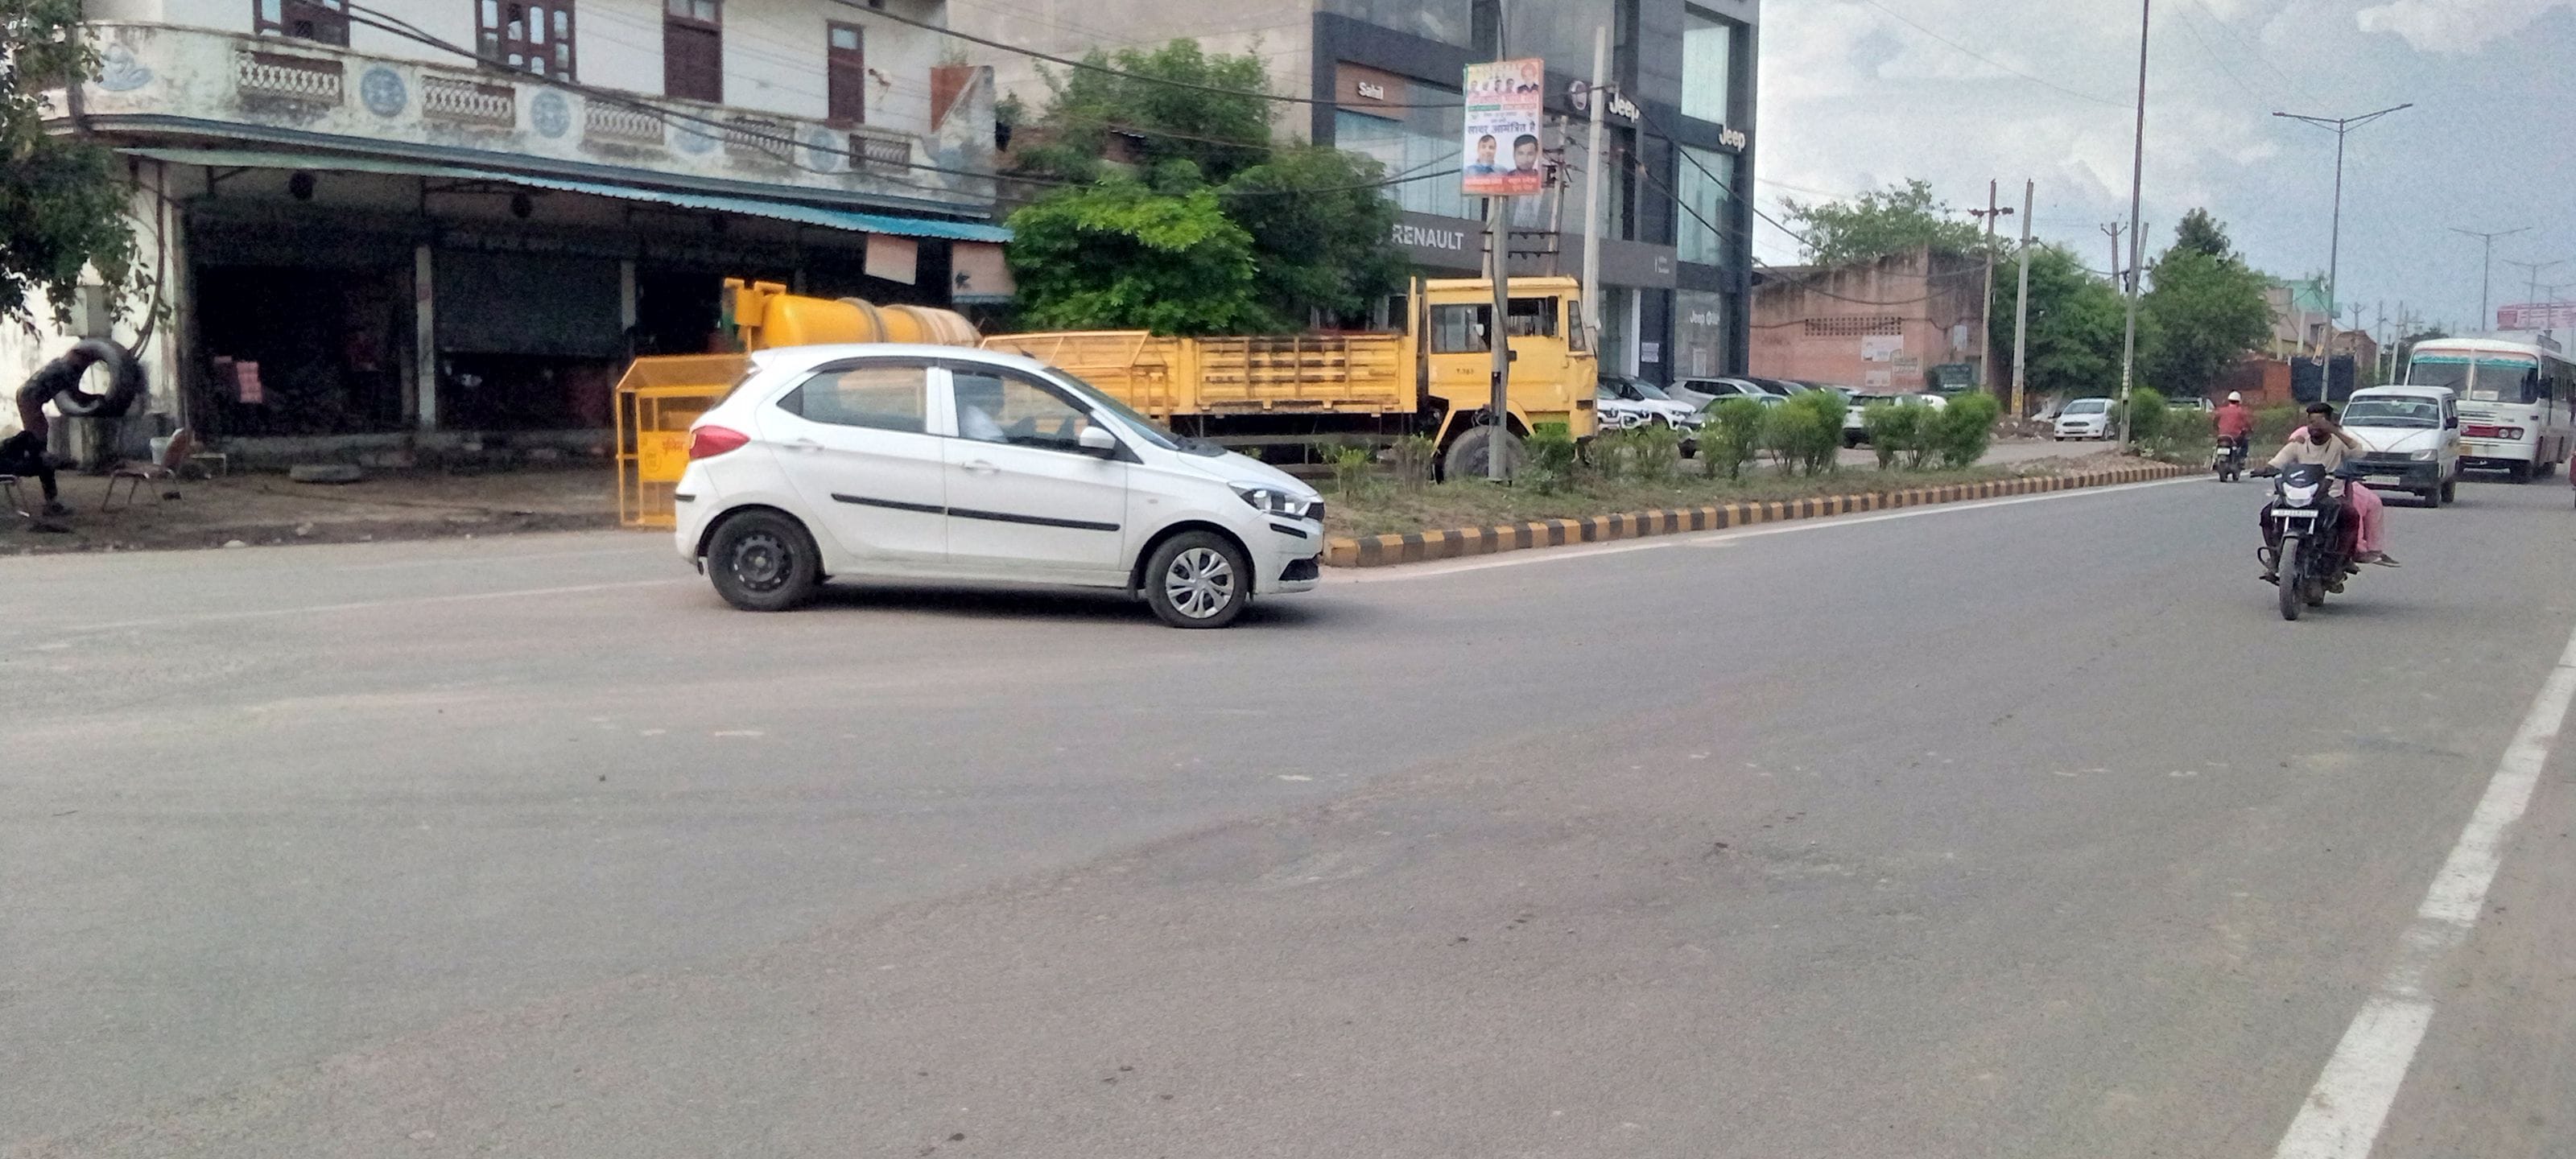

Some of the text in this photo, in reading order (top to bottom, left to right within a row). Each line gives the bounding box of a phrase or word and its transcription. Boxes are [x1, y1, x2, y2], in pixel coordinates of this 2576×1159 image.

[1358, 81, 1384, 101] Sahil
[1609, 90, 1641, 123] Jeep
[1719, 123, 1746, 151] Jeep
[1391, 224, 1464, 251] RENAULT
